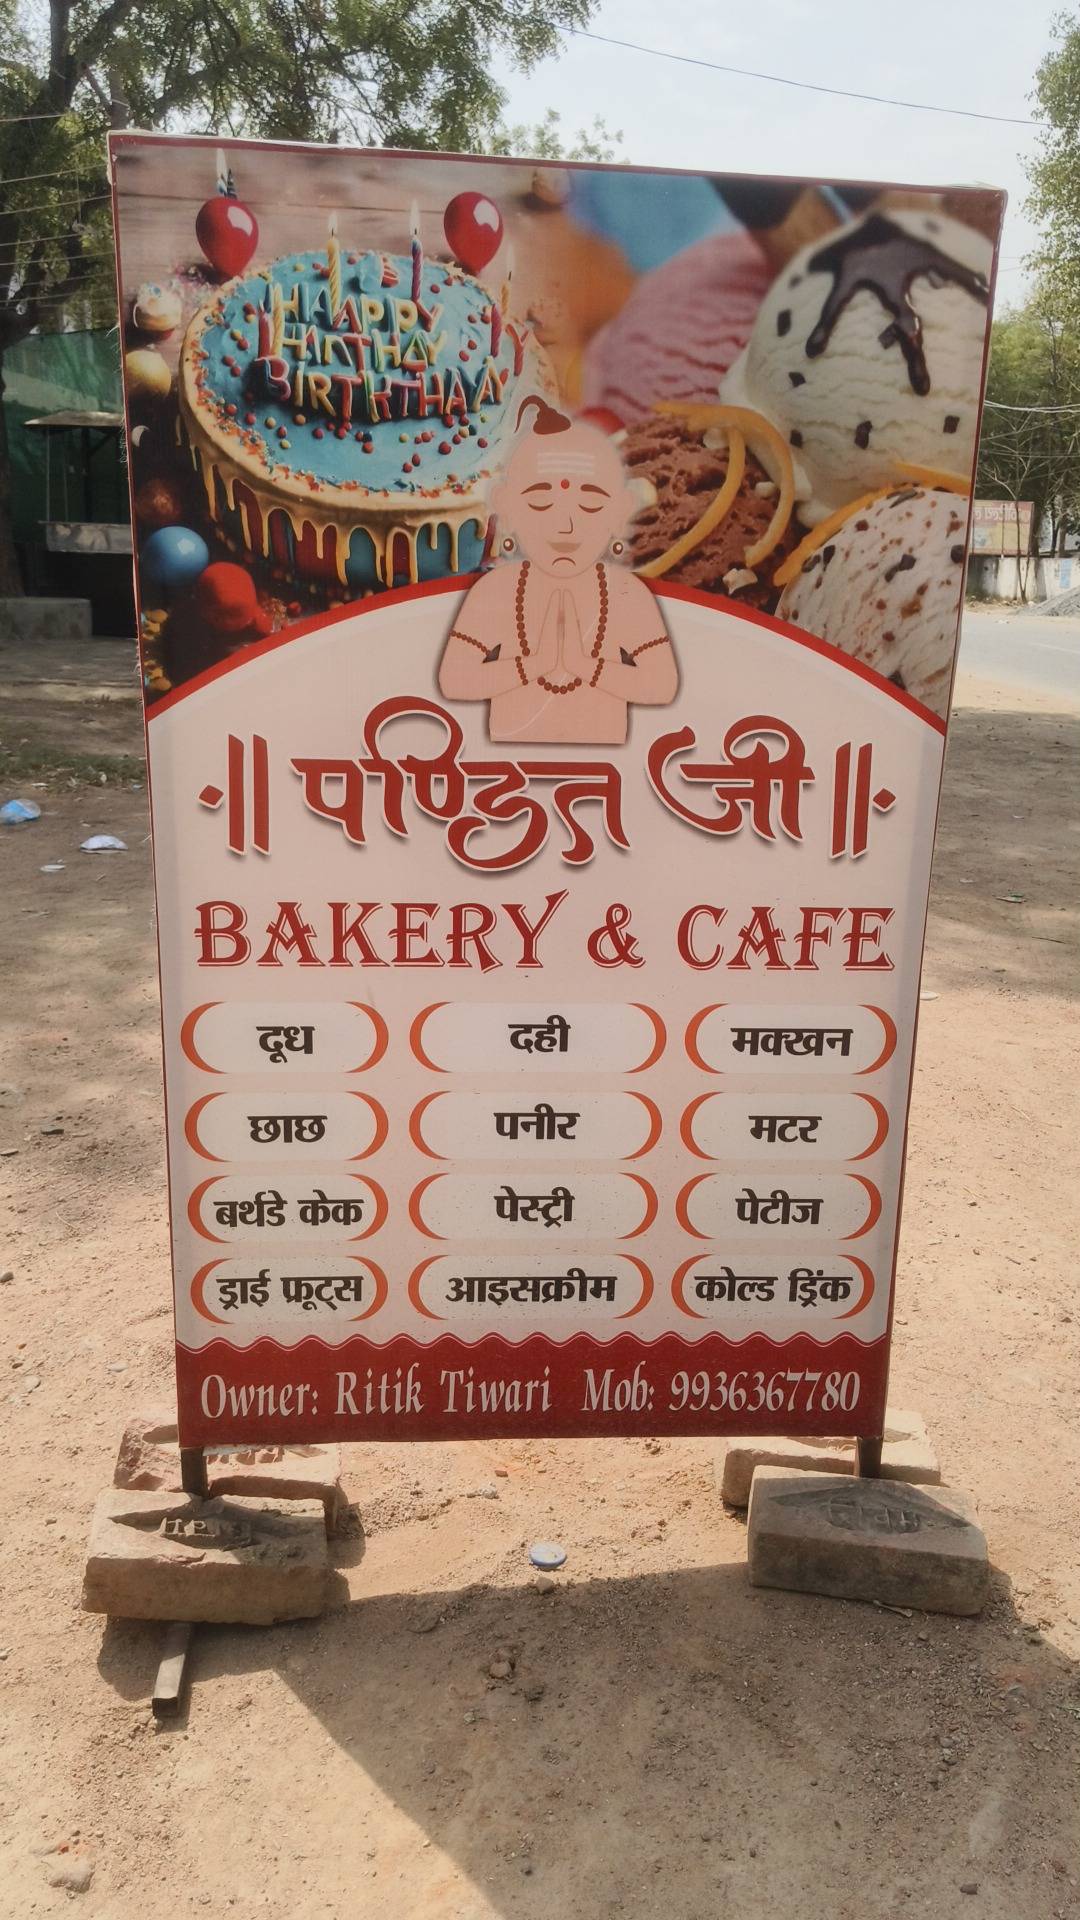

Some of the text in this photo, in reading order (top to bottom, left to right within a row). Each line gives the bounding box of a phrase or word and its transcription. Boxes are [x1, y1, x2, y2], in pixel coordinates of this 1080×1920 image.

[290, 695, 631, 870] पण्डित
[647, 714, 816, 841] जी
[194, 888, 895, 973] BAKERY & CAFE
[255, 1026, 315, 1063] दूध
[507, 1014, 571, 1054] दही
[730, 1027, 854, 1057] मक्खन
[247, 1115, 328, 1143] छाछ
[493, 1103, 581, 1140] पनीर
[748, 1115, 822, 1143] मटर
[213, 1189, 365, 1227] बर्थडे केक
[493, 1185, 576, 1228] पेस्ट्री
[735, 1188, 824, 1225] पेटीज
[215, 1268, 364, 1311] ड्राई फ्रूट्स
[445, 1267, 618, 1306] आइसक्रीम
[694, 1266, 853, 1308] कोल्ड ड्रिंक
[201, 1360, 861, 1419] Owner: Ritik Tiwari Mob: 9936367780
